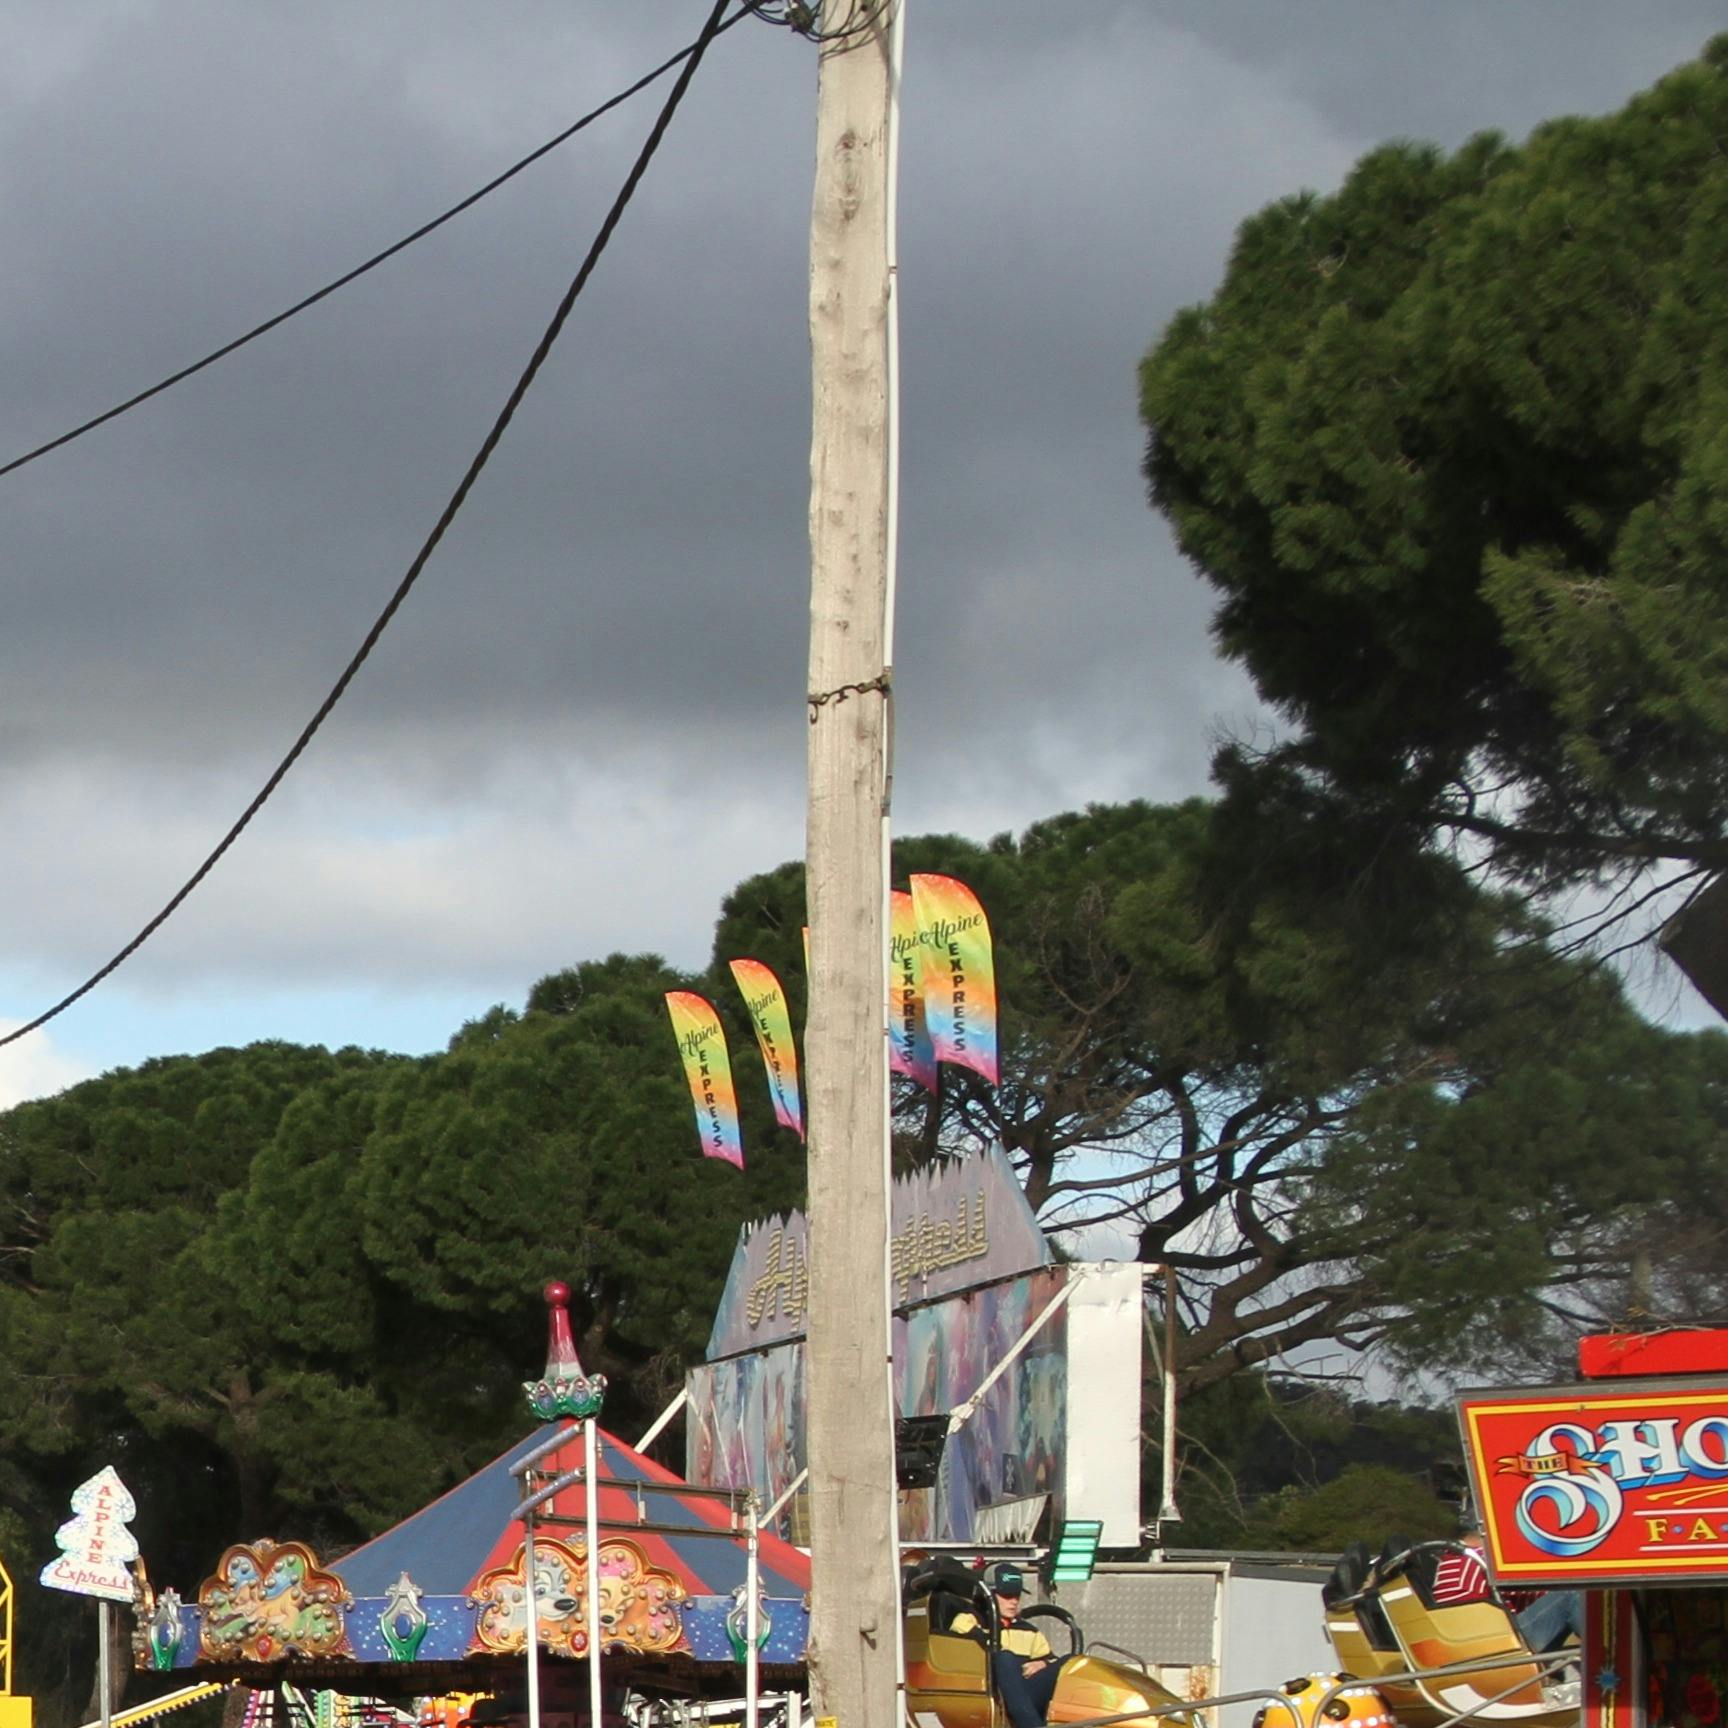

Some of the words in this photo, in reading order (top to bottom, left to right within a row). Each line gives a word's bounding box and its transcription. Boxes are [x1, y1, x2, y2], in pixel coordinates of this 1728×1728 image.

[890, 931, 921, 963] Alpi
[920, 912, 983, 949] Alpine
[902, 956, 916, 1063] EXPRESS
[948, 941, 966, 1051] EXPRESS
[680, 1023, 719, 1057] Alpine
[698, 1049, 724, 1148] EXPRESS
[1522, 1456, 1565, 1472] THE
[87, 1485, 112, 1564] ALPINE
